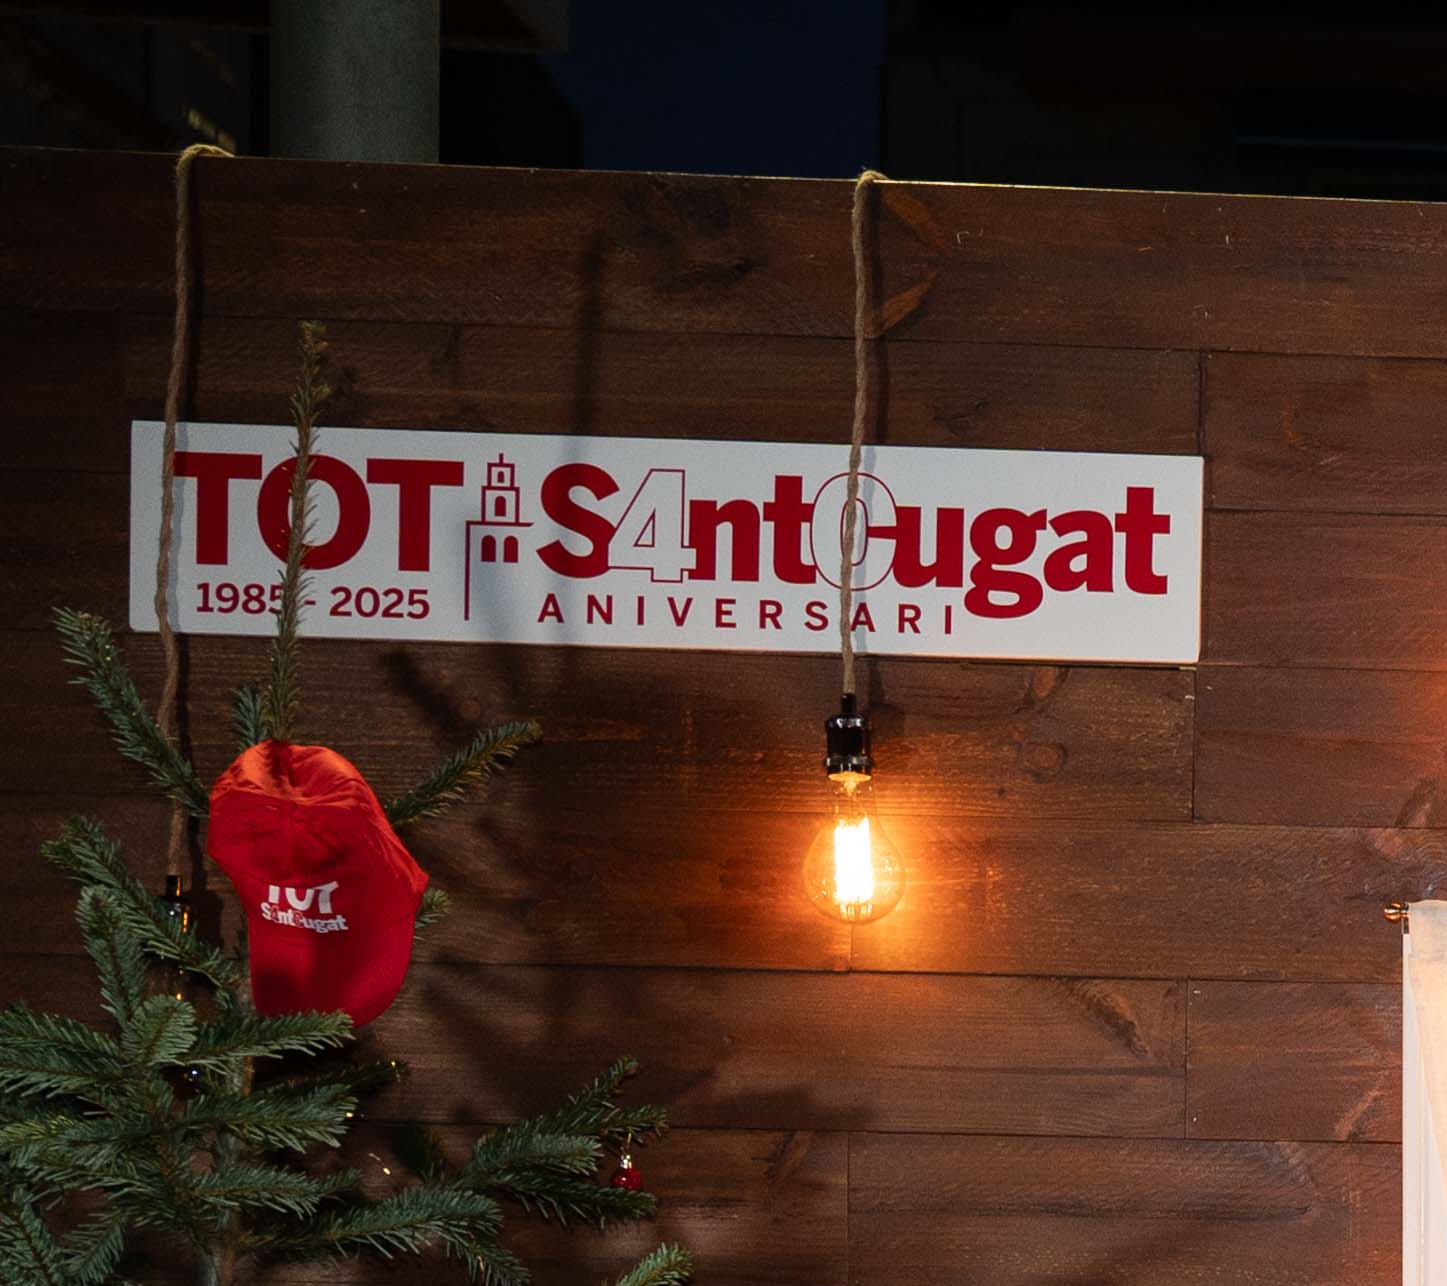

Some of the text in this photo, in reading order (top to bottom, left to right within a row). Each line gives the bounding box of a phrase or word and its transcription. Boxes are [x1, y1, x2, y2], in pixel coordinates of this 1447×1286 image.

[173, 451, 464, 572] TOT
[329, 586, 430, 619] 2025
[537, 592, 952, 635] ANIVERSARI
